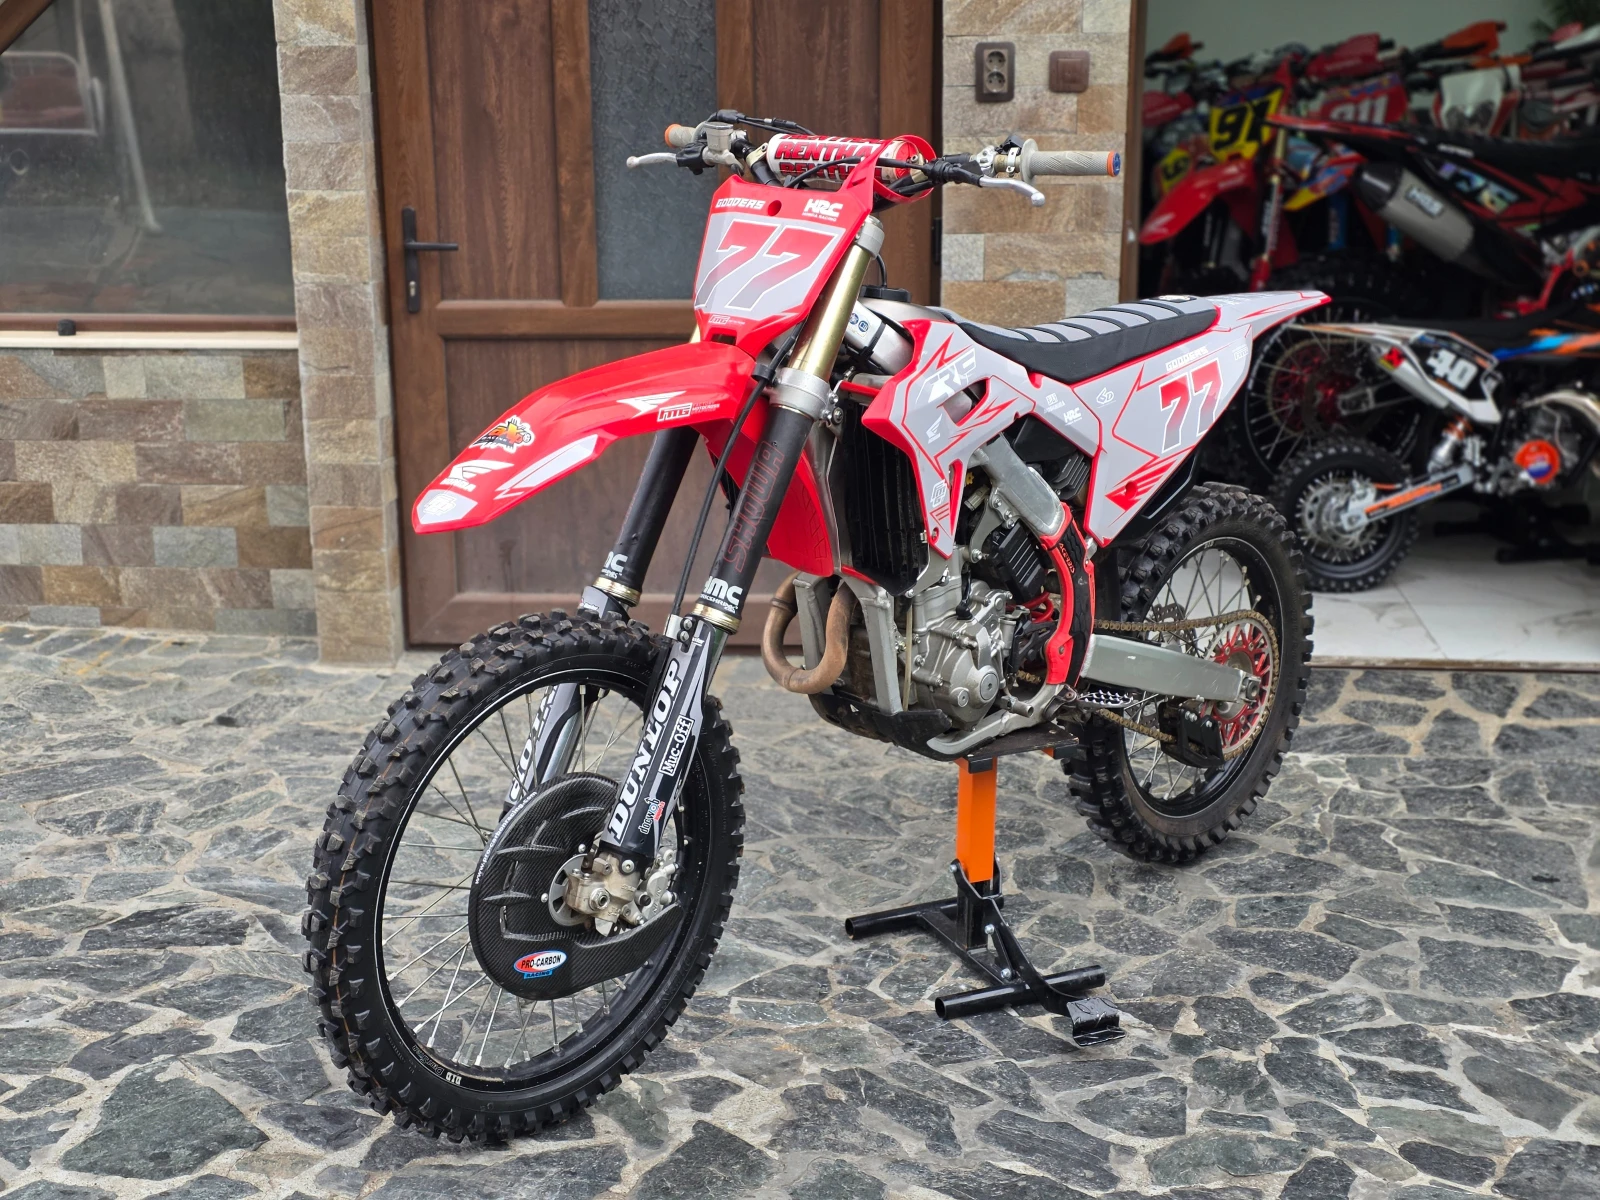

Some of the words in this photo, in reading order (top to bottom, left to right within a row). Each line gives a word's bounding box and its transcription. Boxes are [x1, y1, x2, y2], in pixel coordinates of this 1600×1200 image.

[775, 140, 874, 161] RENTHA
[715, 197, 766, 210] GOODERS
[803, 198, 843, 218] HRC
[694, 218, 838, 312] 77
[1159, 357, 1223, 454] 77
[722, 440, 784, 572] SHOWA
[607, 657, 683, 843] DUNLOP
[661, 716, 692, 775] Muc-Off
[474, 790, 538, 885] www.pro-carbonracing.com
[521, 954, 562, 969] PRO-CARBON
[446, 1071, 463, 1085] DID
